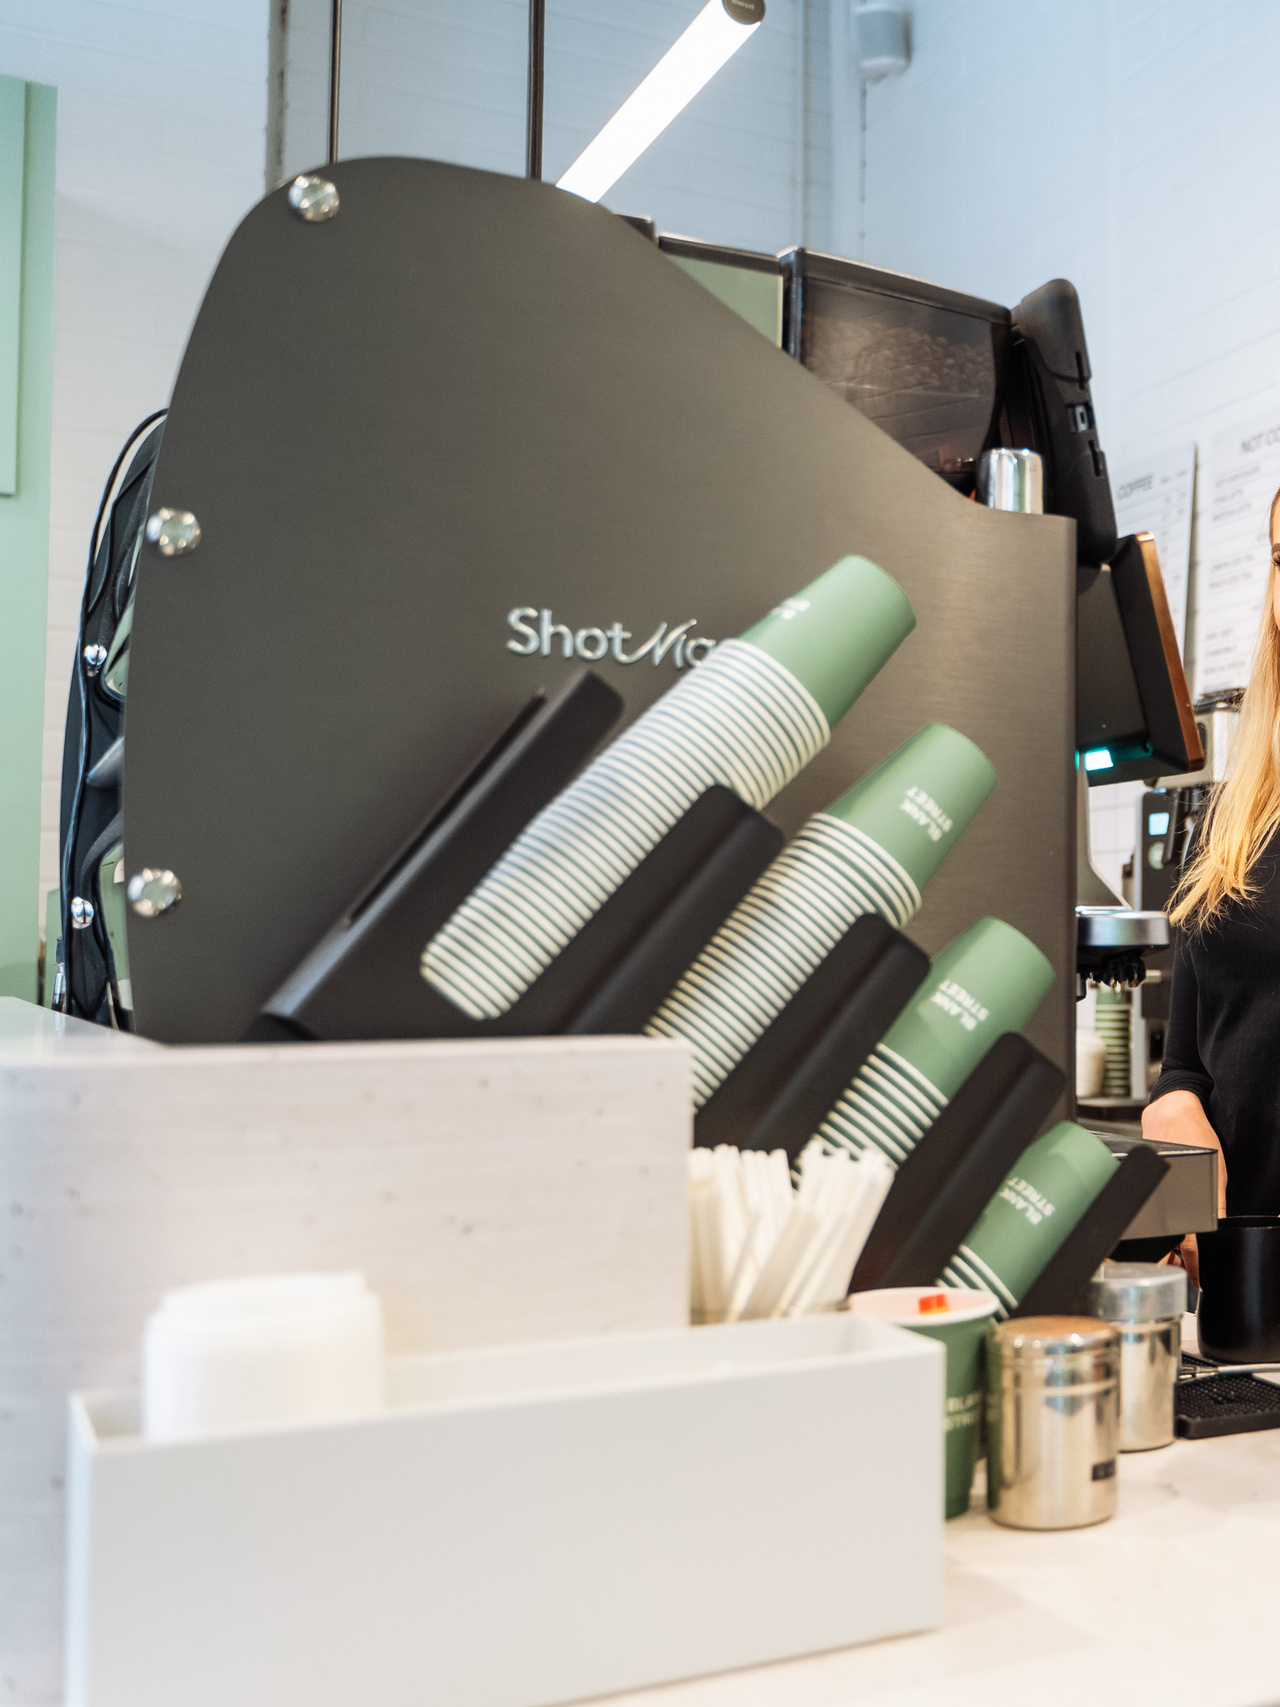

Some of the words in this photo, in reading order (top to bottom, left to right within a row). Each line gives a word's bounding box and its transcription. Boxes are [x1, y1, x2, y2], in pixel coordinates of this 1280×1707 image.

[1240, 433, 1263, 454] NOT
[900, 798, 943, 842] BLANK
[906, 786, 953, 834] STREET
[930, 991, 977, 1032] BLANK
[939, 978, 990, 1022] STREET
[999, 1187, 1043, 1226] BLANK
[1007, 1176, 1056, 1217] STREET
